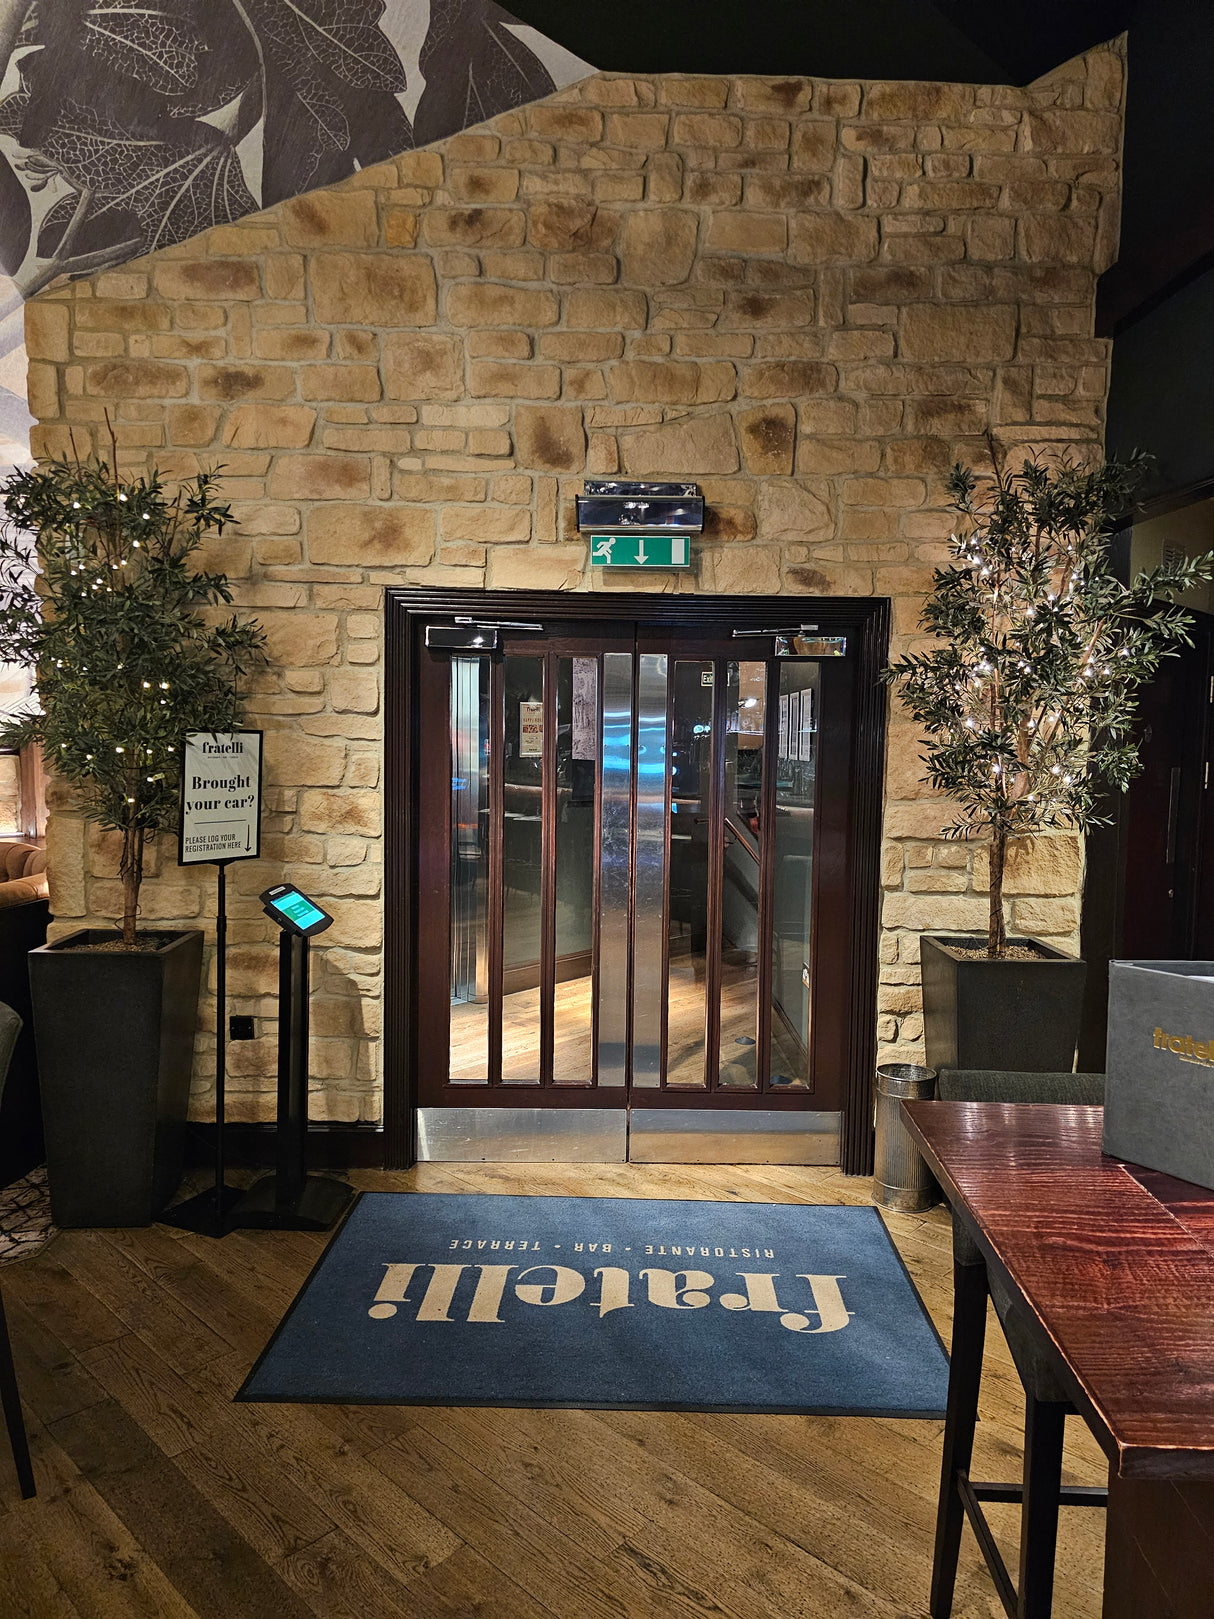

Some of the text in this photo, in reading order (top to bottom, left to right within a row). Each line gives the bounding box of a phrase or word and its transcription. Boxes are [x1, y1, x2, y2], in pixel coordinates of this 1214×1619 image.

[202, 741, 243, 753] fratelli
[192, 775, 251, 792] Brought
[185, 795, 255, 815] your car?
[185, 833, 236, 844] PLEASE LOG YOUR
[185, 841, 242, 853] REGISTRATION HERE
[449, 1239, 775, 1259] RISTORANTE BAR TERRACE
[367, 1263, 856, 1334] fratelli
